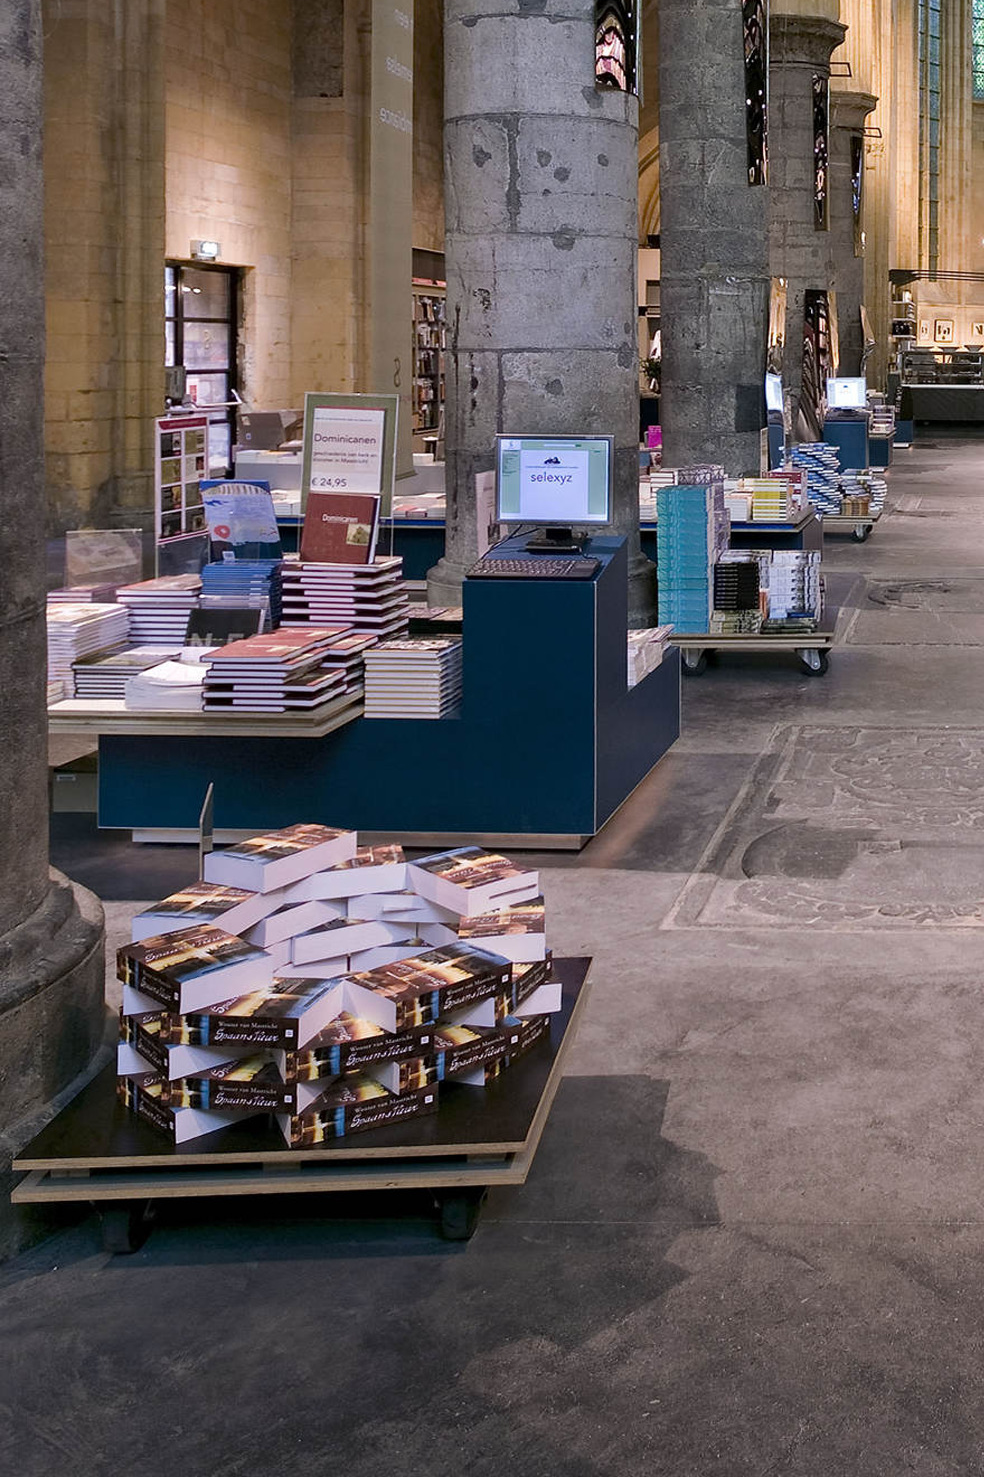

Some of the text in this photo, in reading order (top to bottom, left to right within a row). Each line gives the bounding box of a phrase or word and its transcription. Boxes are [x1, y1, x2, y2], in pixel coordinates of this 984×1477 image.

[314, 433, 377, 445] Dominicanen
[320, 478, 347, 488] 24,95
[530, 471, 573, 485] selexyz
